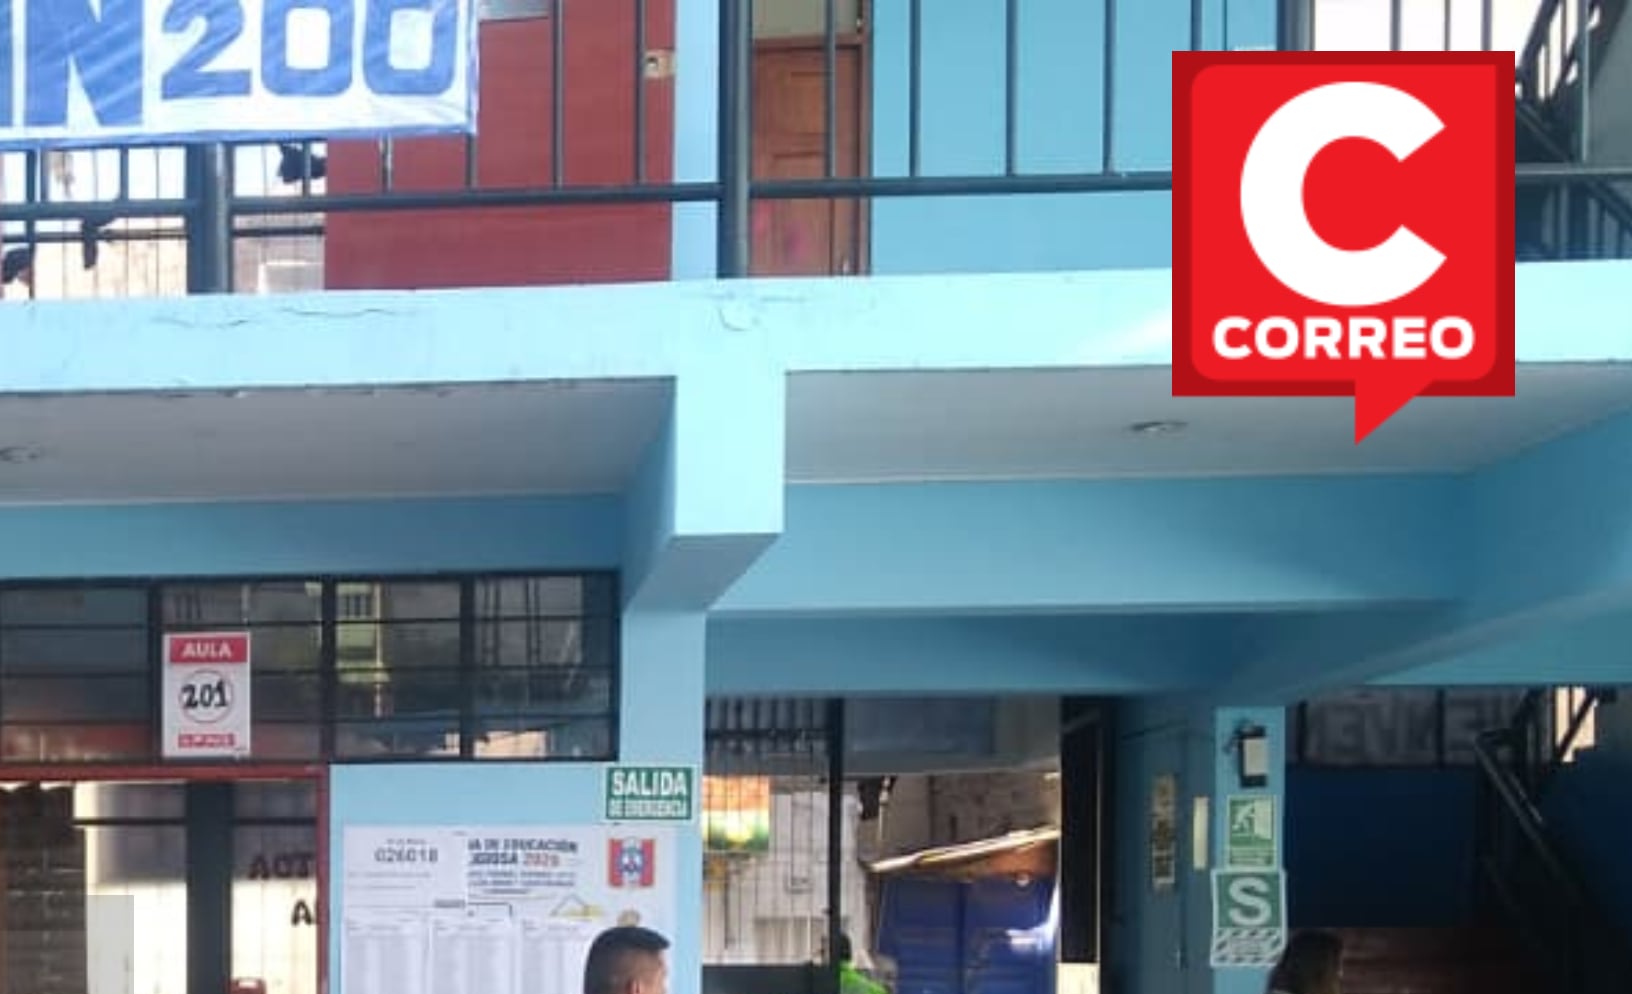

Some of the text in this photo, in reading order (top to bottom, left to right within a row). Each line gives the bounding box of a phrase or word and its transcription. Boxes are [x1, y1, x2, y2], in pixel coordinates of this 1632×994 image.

[161, 0, 460, 100] 200
[181, 640, 232, 659] AULA
[180, 677, 228, 710] 201
[612, 770, 688, 796] SALIDA
[1228, 876, 1272, 928] S
